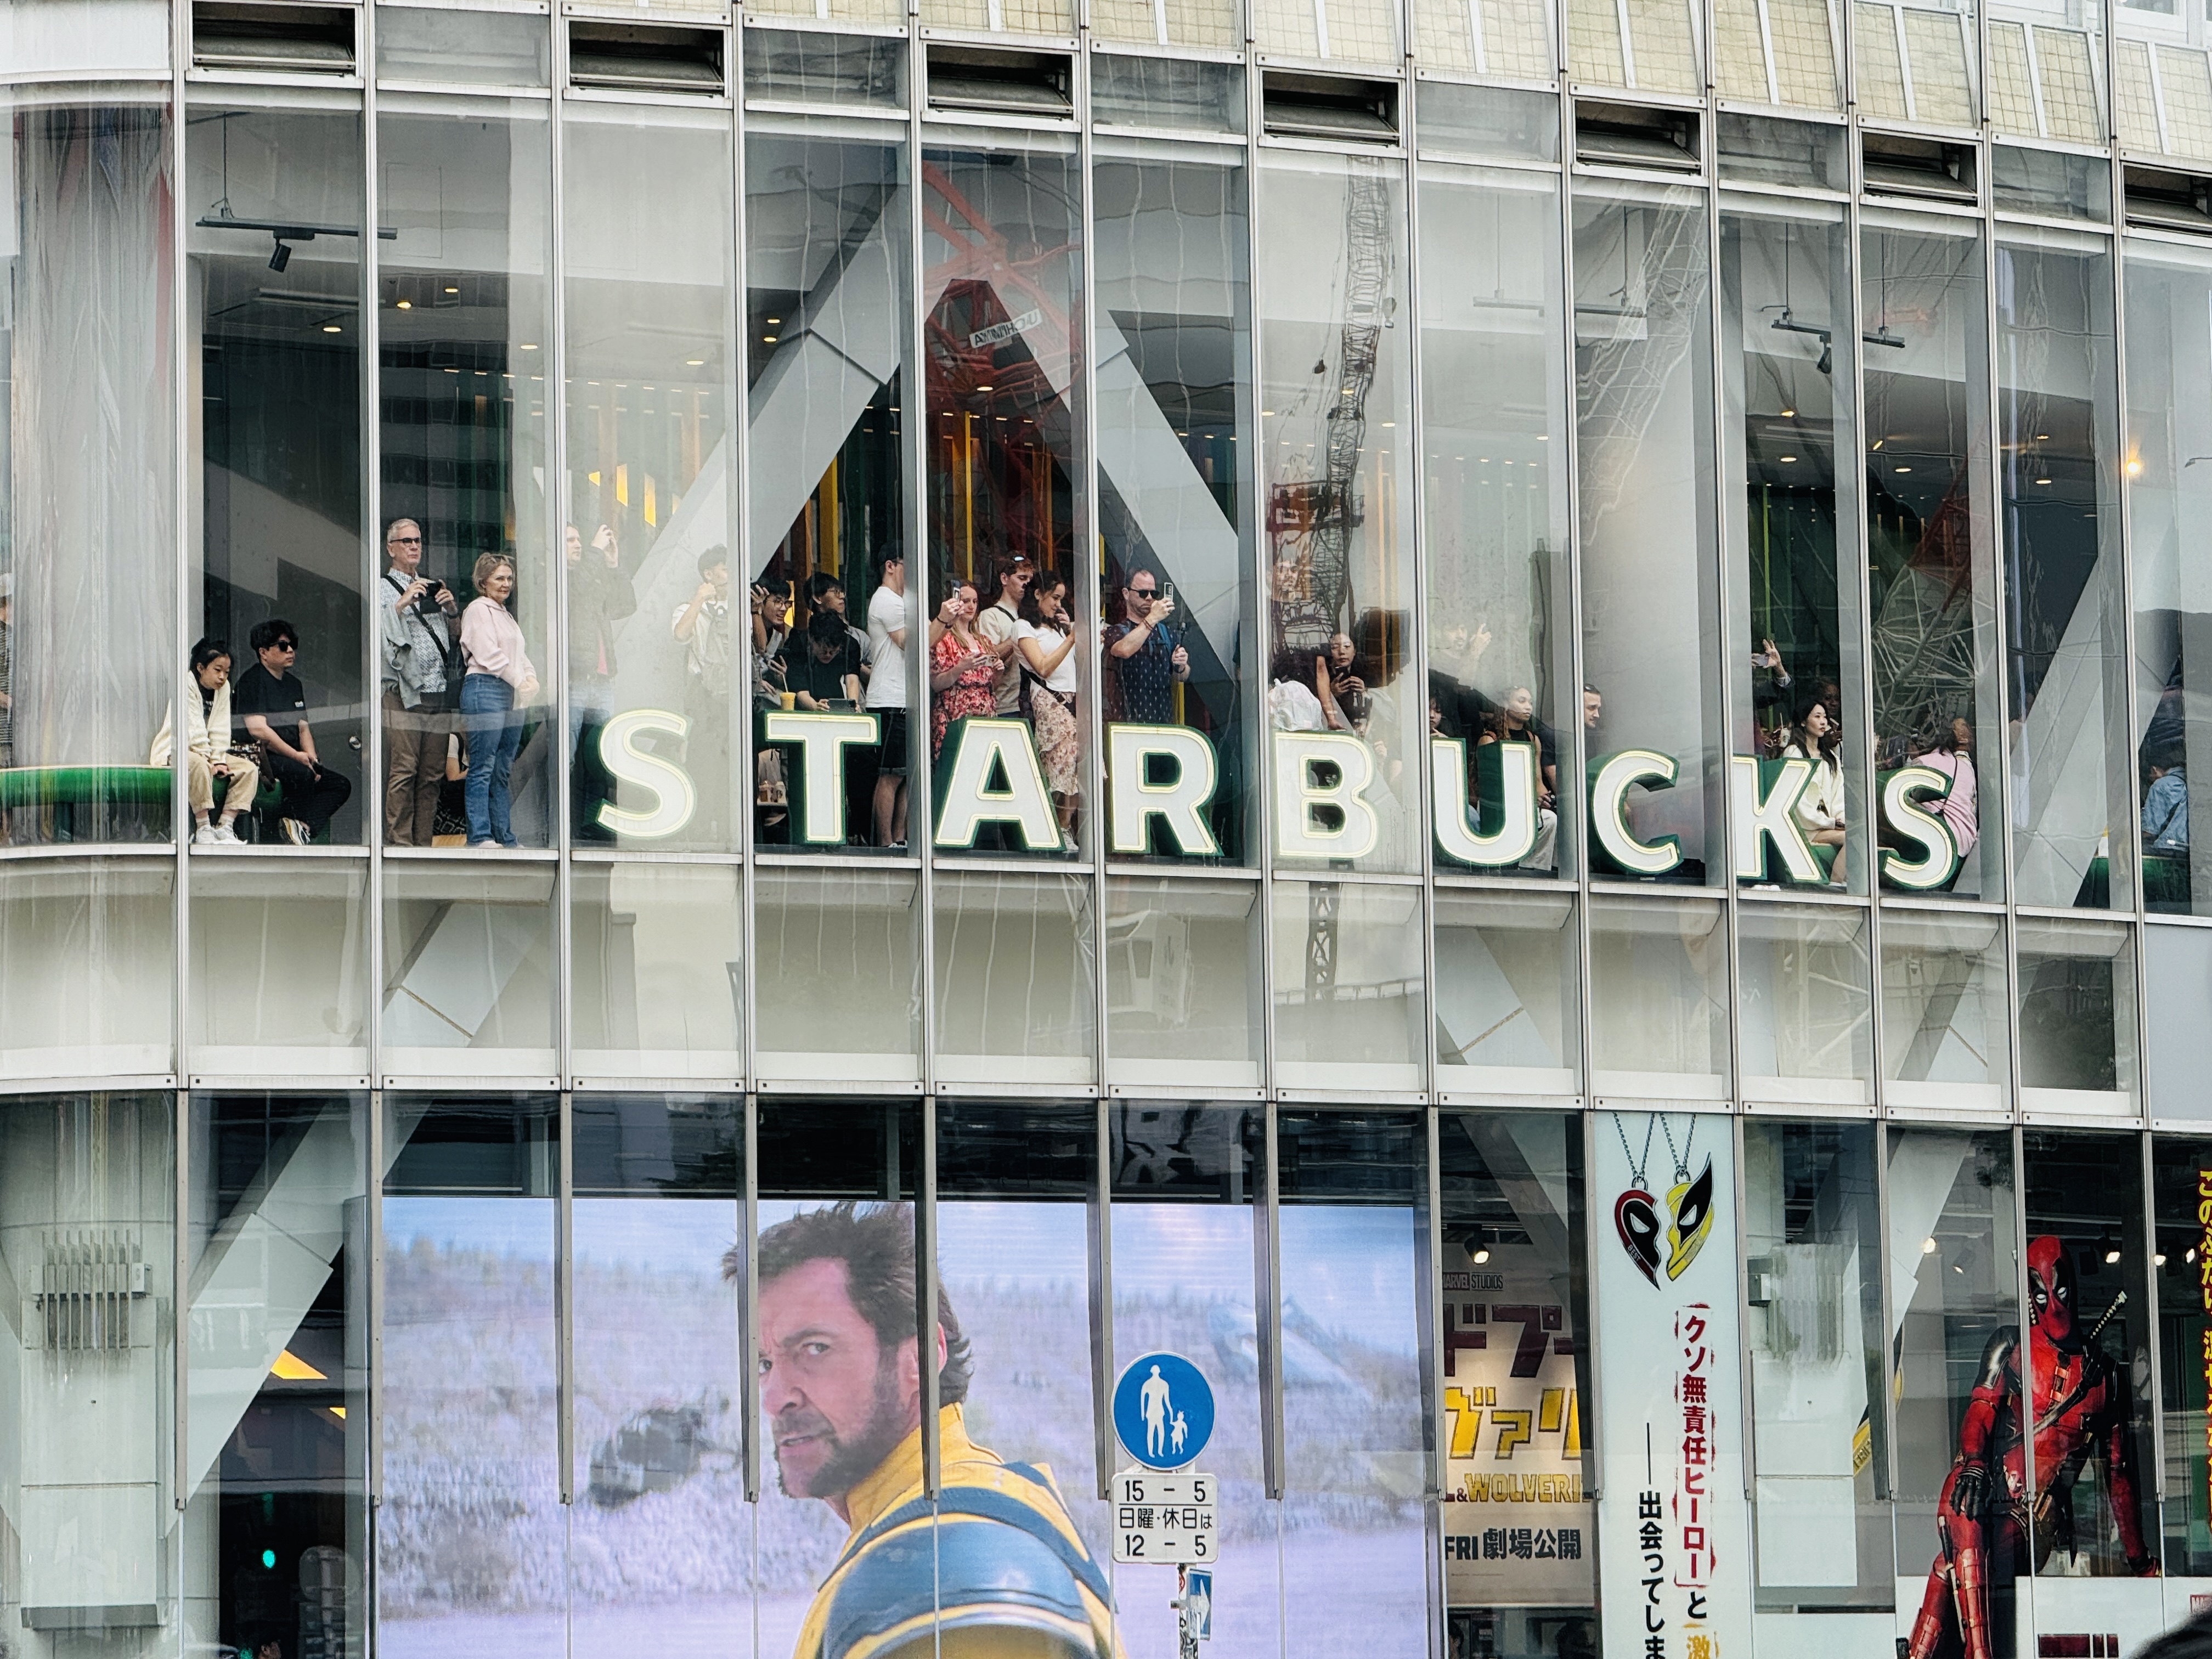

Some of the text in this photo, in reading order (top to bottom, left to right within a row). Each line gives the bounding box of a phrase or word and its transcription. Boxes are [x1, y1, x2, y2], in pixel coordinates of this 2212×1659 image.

[596, 708, 1960, 890] STARBUCKS
[1627, 1244, 1641, 1262] BEST
[1471, 1274, 1503, 1289] STUDIOS
[1125, 1480, 1144, 1502] 15
[1194, 1481, 1206, 1502] 5
[1125, 1534, 1144, 1556] 12
[1195, 1535, 1206, 1556] 5
[1445, 1527, 1582, 1560] FRI 劇場公開
